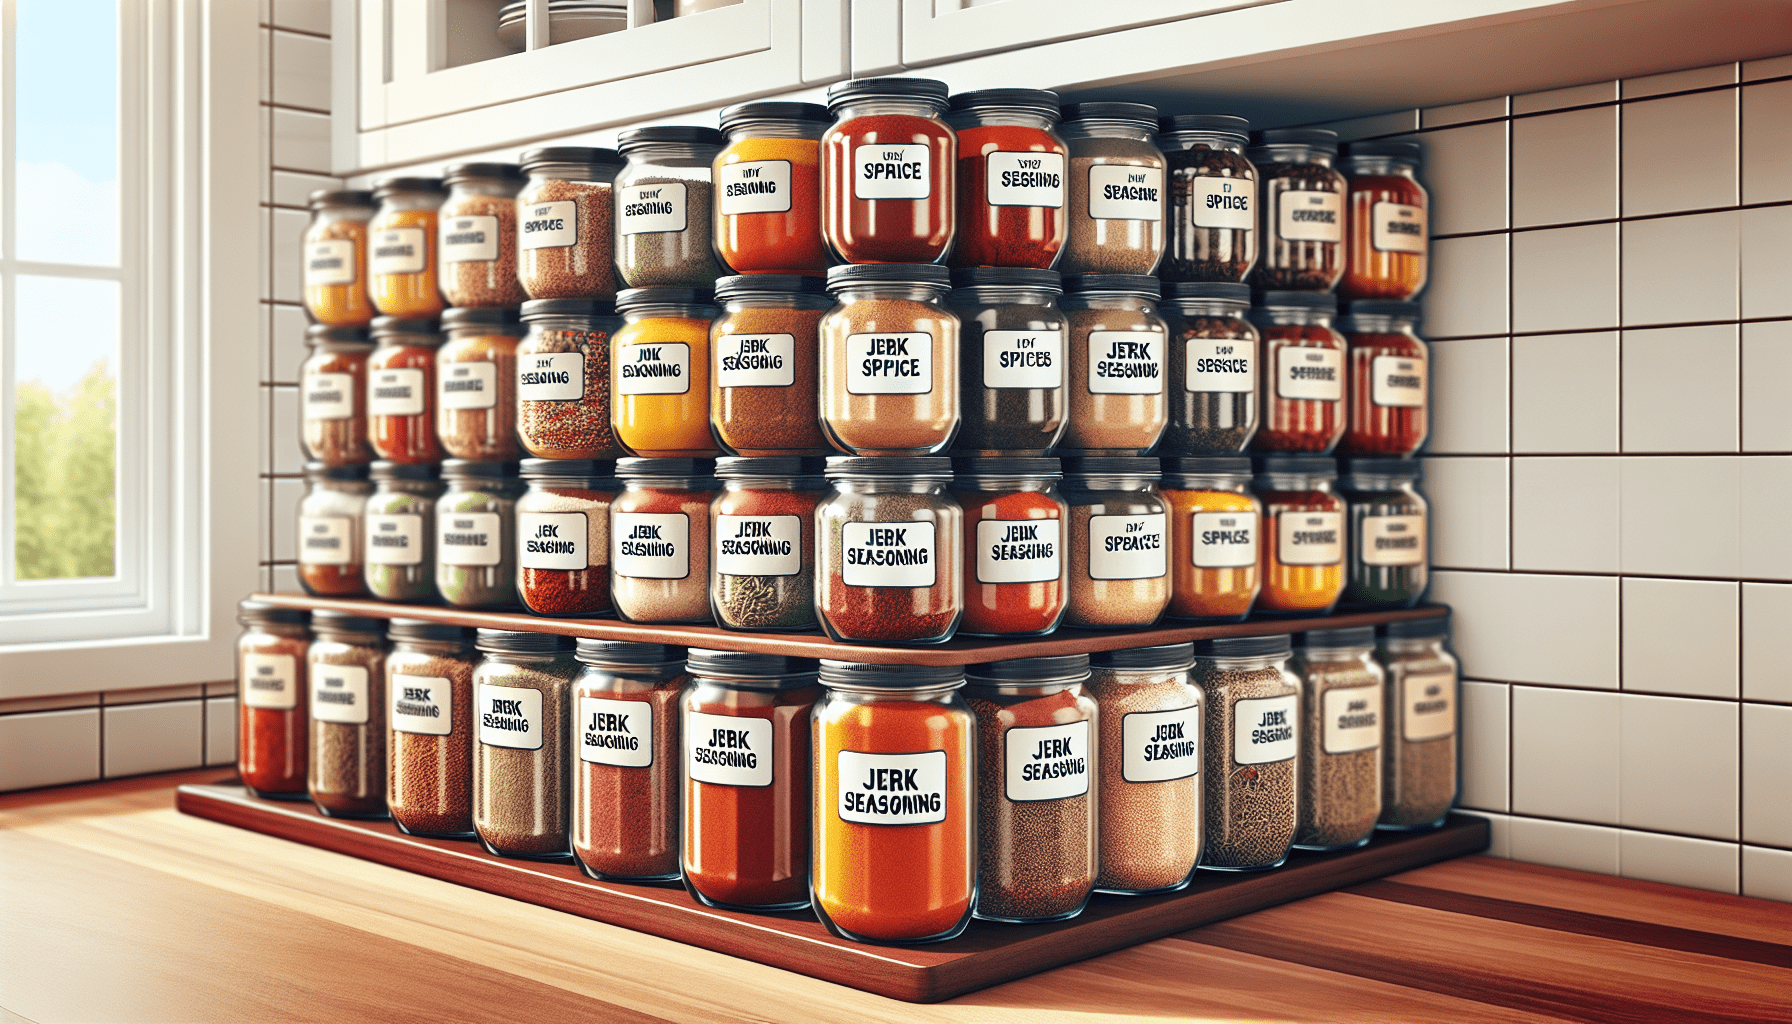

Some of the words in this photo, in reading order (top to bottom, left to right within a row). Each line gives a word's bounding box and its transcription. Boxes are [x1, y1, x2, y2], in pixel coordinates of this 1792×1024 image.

[1106, 342, 1151, 360] JERK
[847, 548, 928, 566] SEASONING
[1032, 736, 1072, 760] JERK
[863, 768, 918, 791] JERK
[844, 791, 941, 815] SEASONING
